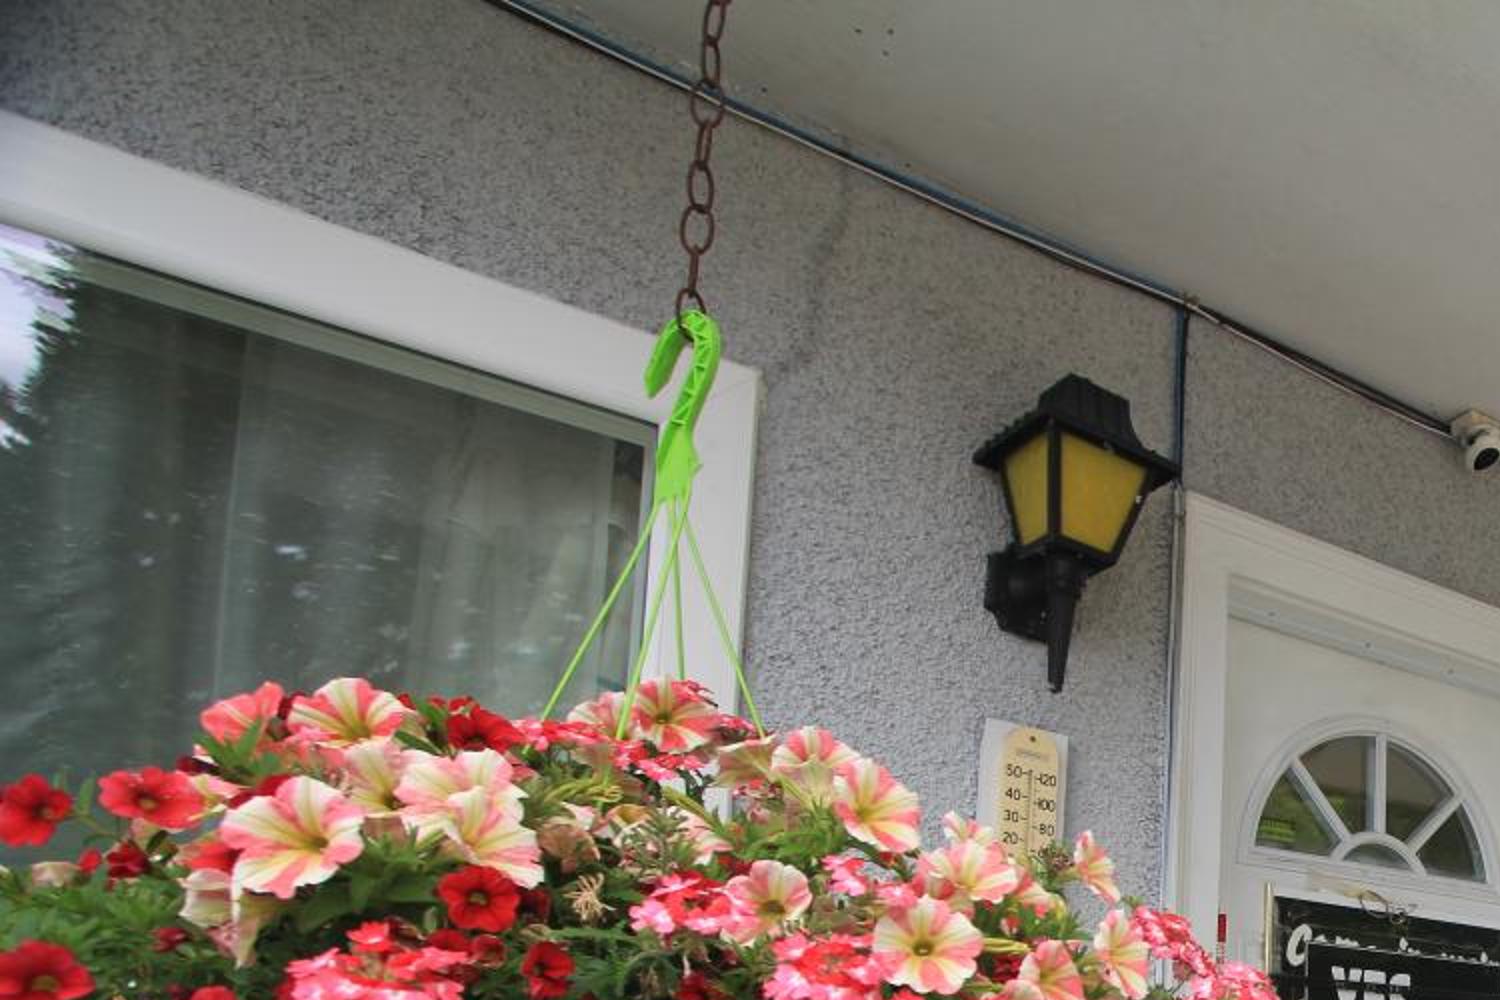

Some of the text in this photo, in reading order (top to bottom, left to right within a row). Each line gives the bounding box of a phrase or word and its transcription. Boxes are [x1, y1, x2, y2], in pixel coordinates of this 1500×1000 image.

[1007, 763, 1022, 778] 50
[1005, 787, 1021, 801] 40
[1003, 809, 1019, 822] 30
[1002, 832, 1018, 845] 20
